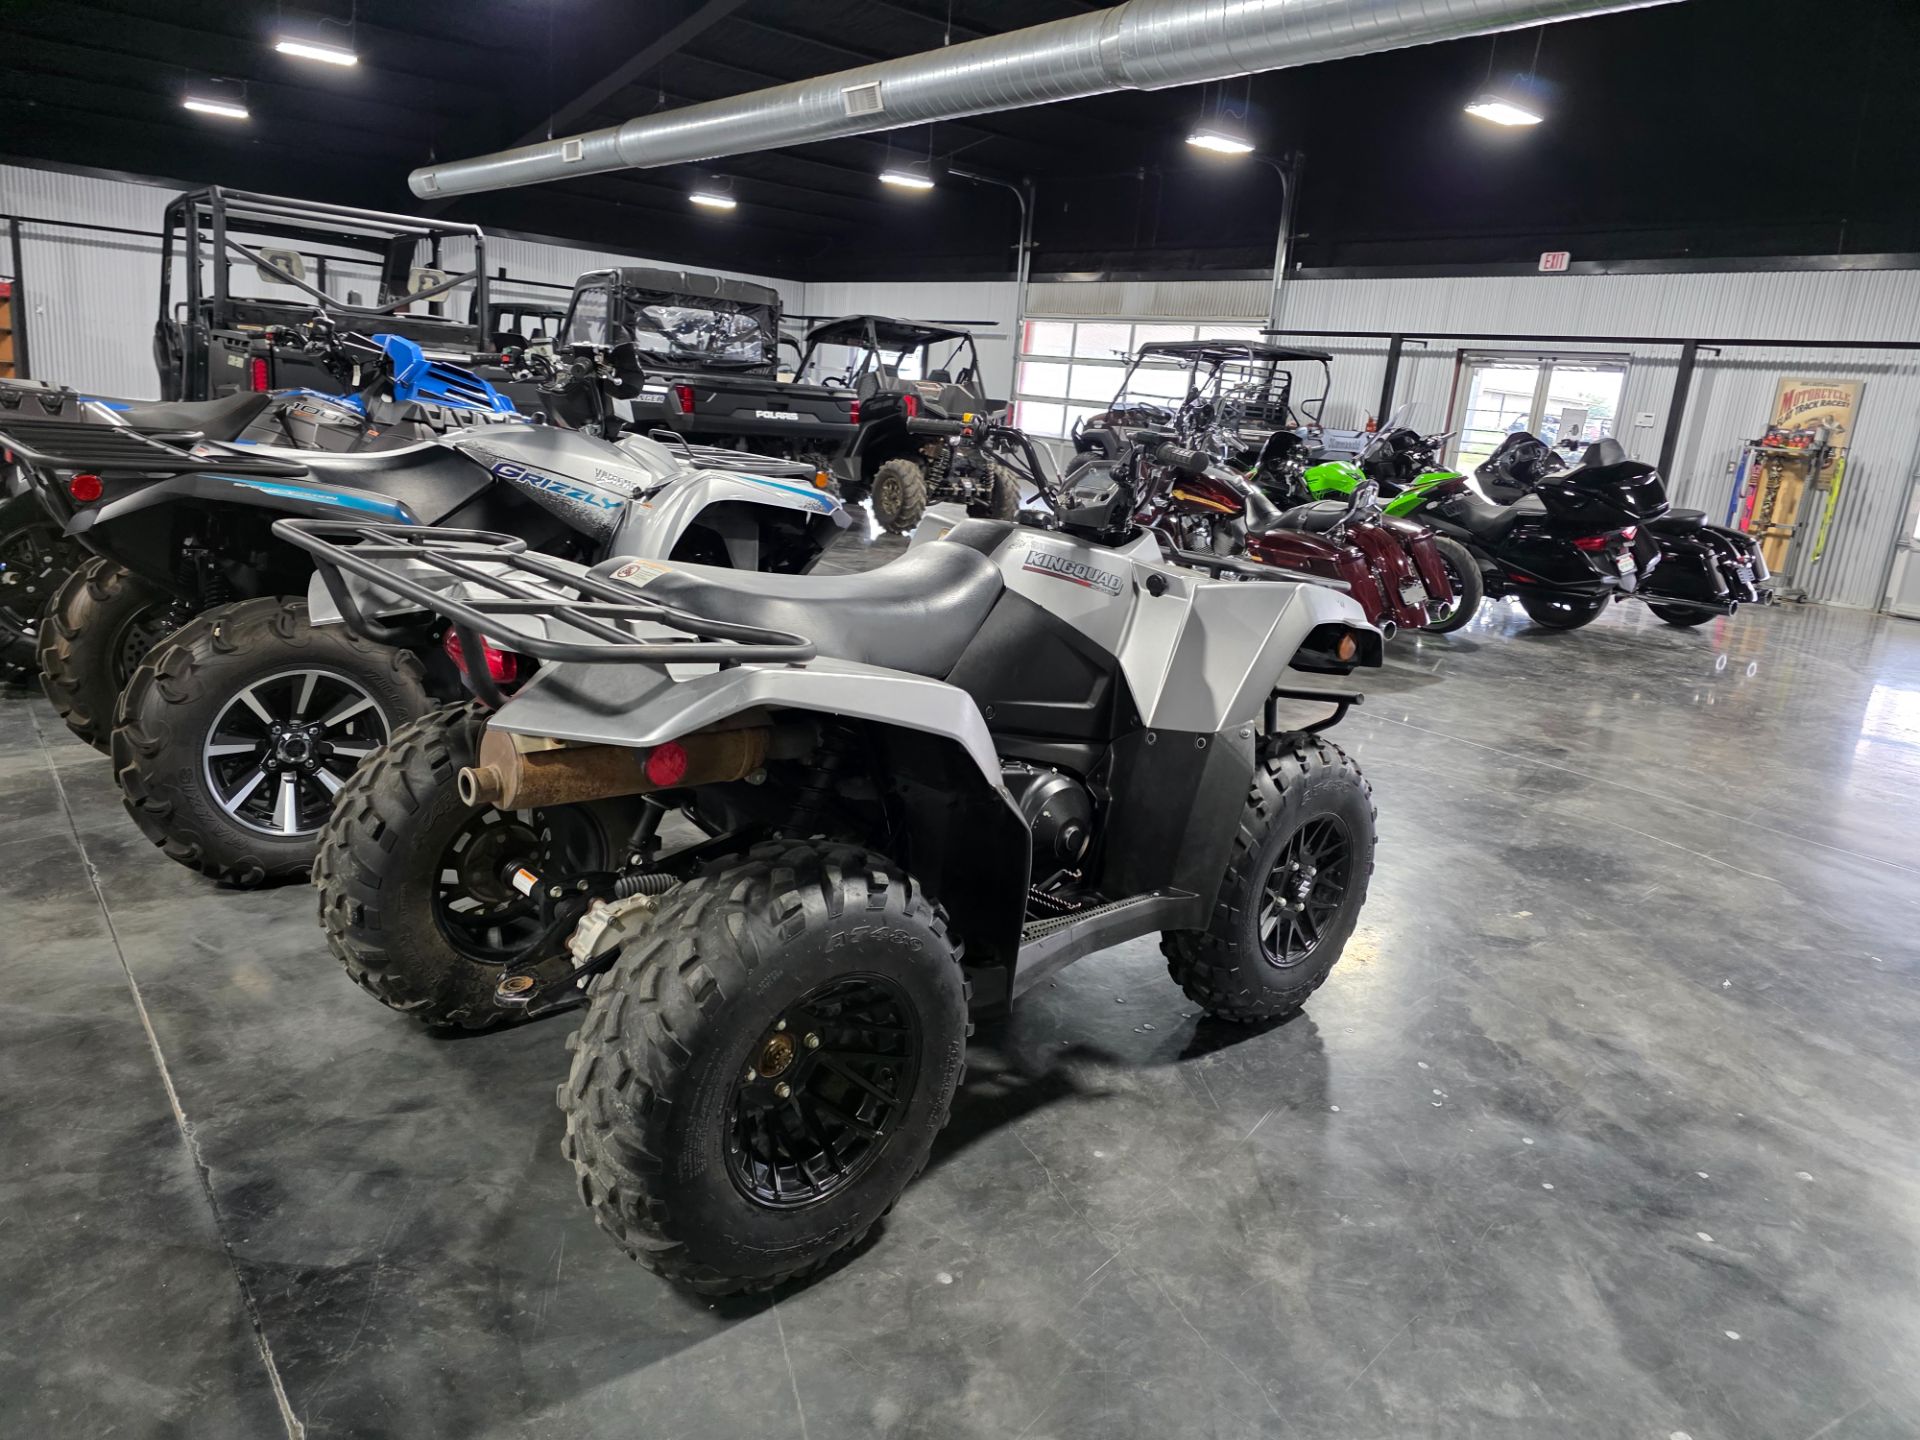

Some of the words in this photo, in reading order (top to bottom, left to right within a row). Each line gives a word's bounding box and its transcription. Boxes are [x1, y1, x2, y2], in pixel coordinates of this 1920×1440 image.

[1544, 253, 1566, 270] EXIT
[755, 410, 798, 421] POLARIS
[1780, 387, 1851, 416] MOTORCYCLE
[491, 463, 625, 510] GRIZZLY
[1025, 550, 1123, 592] KINGQUAD
